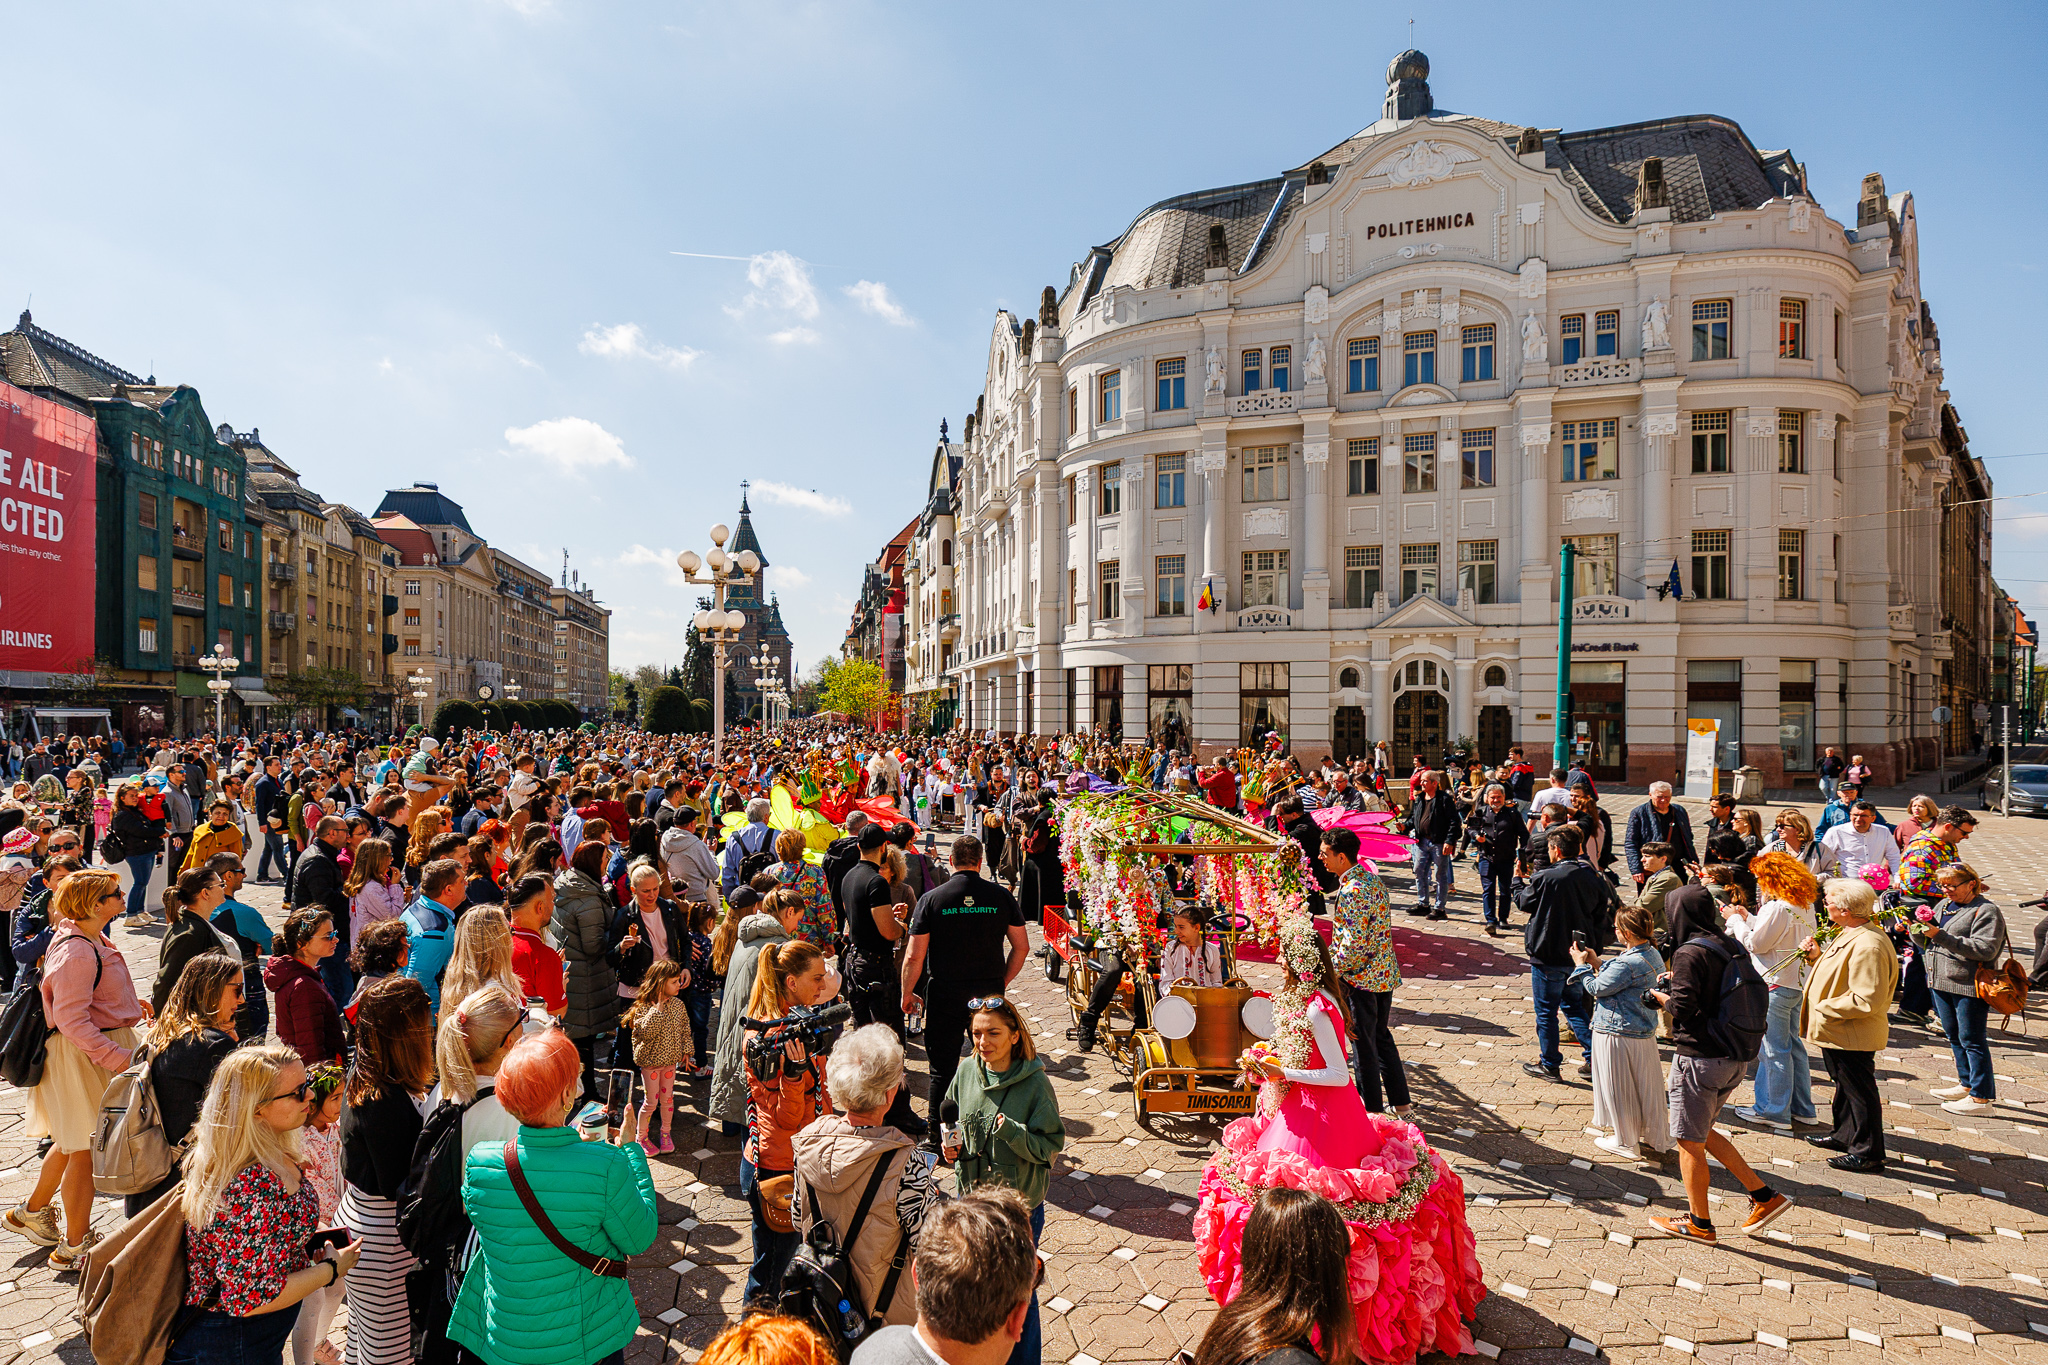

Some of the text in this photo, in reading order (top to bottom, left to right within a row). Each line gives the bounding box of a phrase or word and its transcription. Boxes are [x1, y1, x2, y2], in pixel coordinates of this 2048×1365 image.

[1367, 212, 1475, 240] POLITEHNICA
[19, 457, 64, 501] ALL
[1, 497, 64, 542] CTED
[11, 544, 28, 555] than
[29, 548, 41, 559] any
[42, 551, 62, 562] other.
[0, 629, 53, 650] IRLINES
[1613, 642, 1639, 652] Bank
[942, 906, 998, 915] SAR SECURITY
